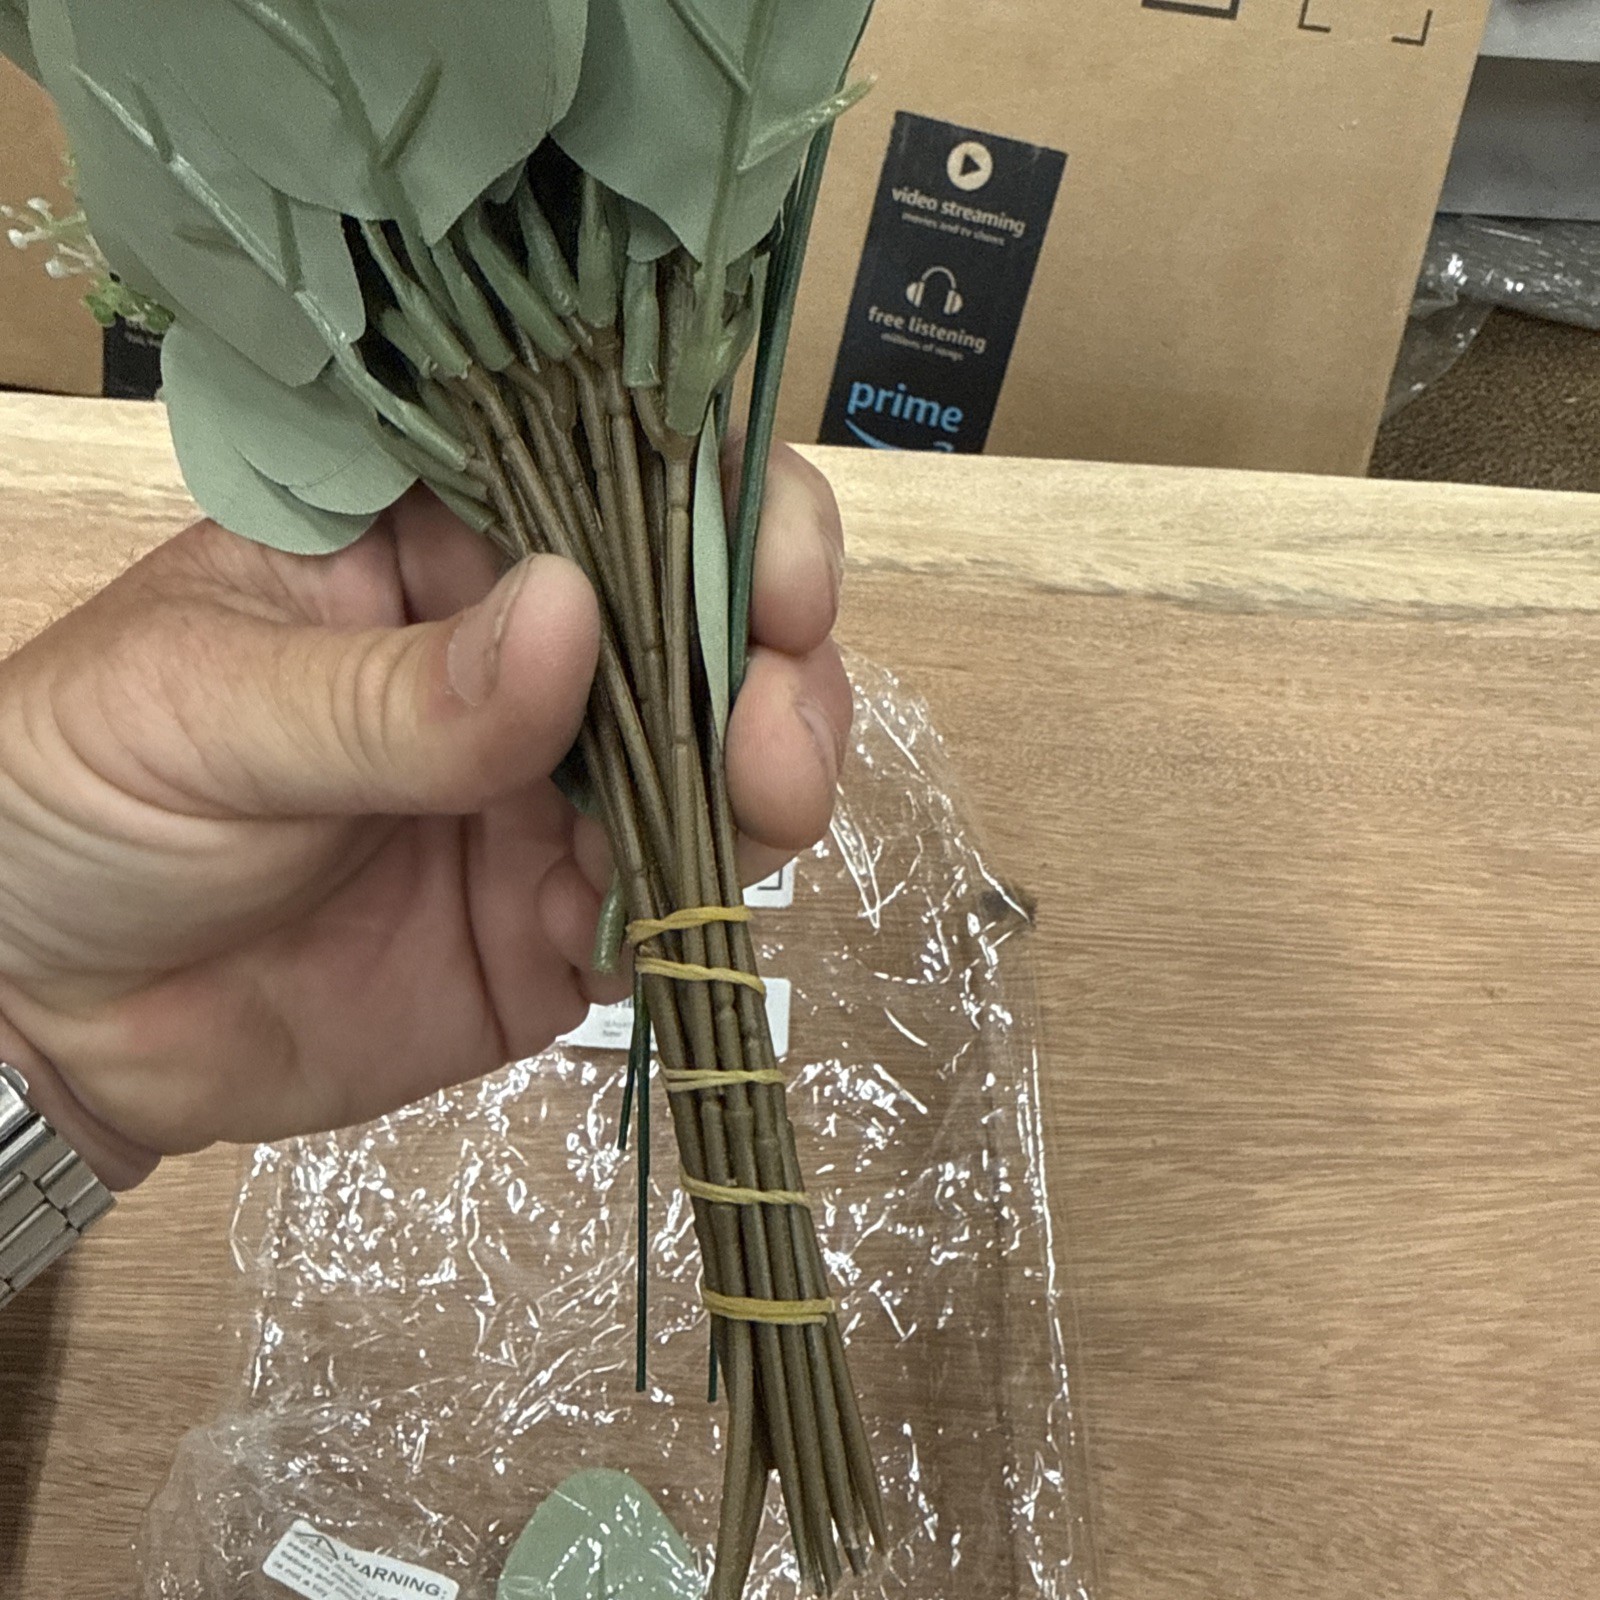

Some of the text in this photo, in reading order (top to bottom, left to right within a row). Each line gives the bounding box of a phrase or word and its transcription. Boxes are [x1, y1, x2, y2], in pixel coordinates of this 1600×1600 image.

[891, 186, 1026, 238] video streaming
[868, 305, 987, 354] free listening
[847, 381, 964, 433] prime
[344, 1552, 447, 1600] WARNING:
